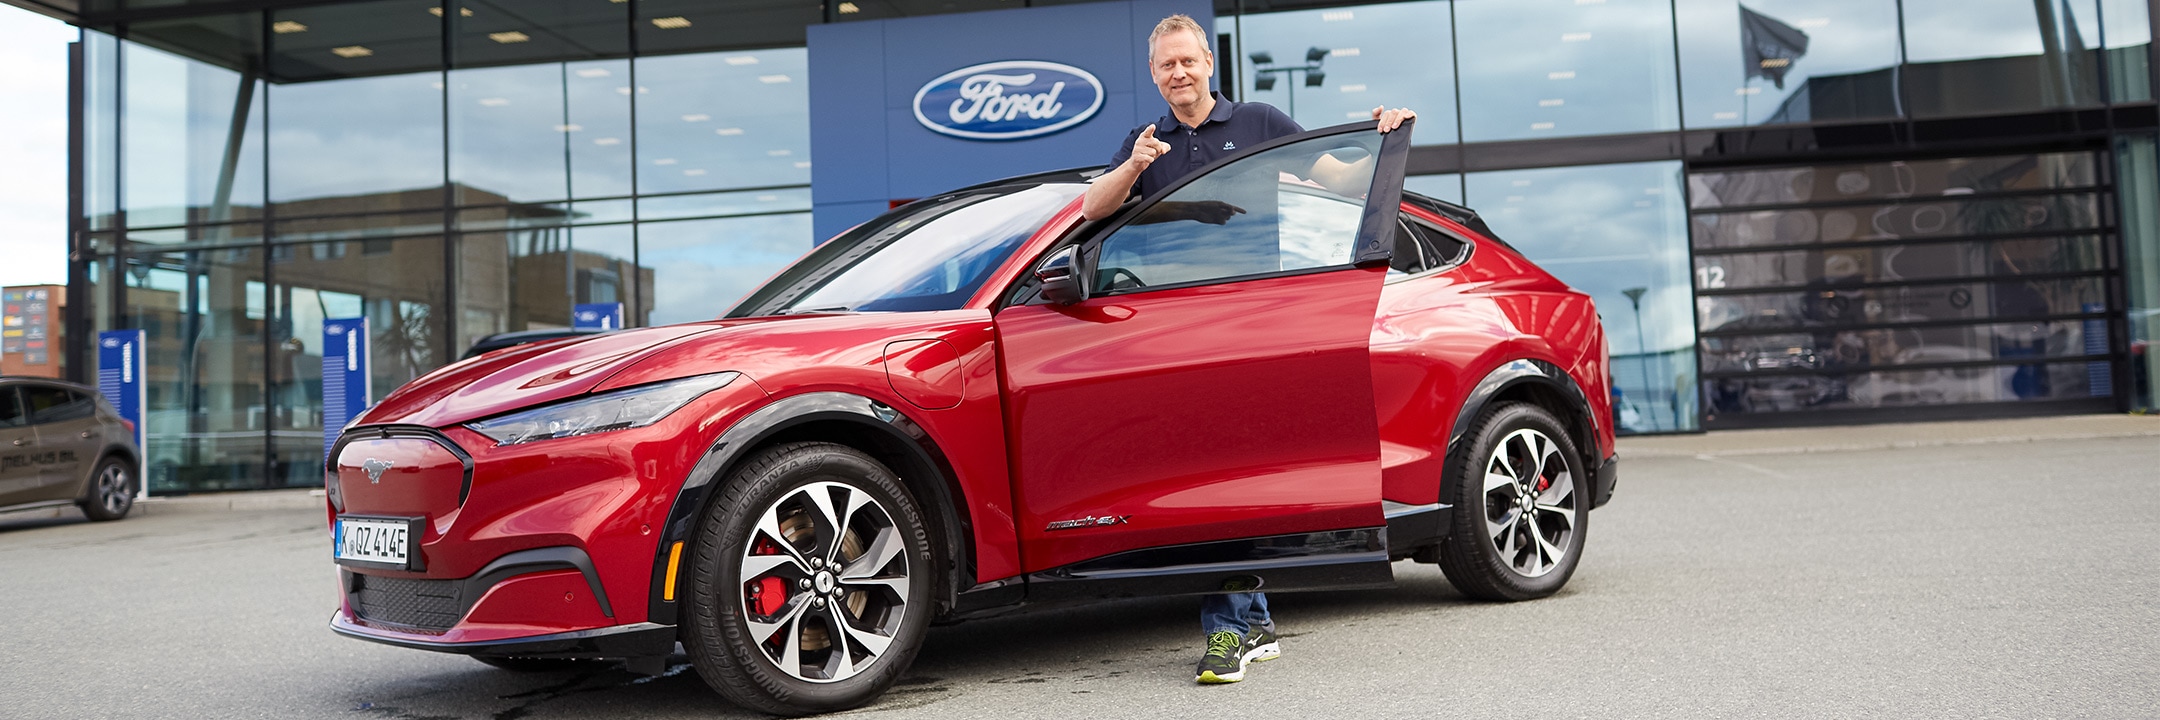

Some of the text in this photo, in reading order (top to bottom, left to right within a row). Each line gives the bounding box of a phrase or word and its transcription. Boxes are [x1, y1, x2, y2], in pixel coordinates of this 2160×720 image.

[949, 73, 1065, 124] Ford
[1696, 266, 1726, 289] 12
[733, 460, 800, 518] TURANZA
[866, 467, 931, 561] BRIDGESTONE
[341, 526, 406, 559] K QZ 414E
